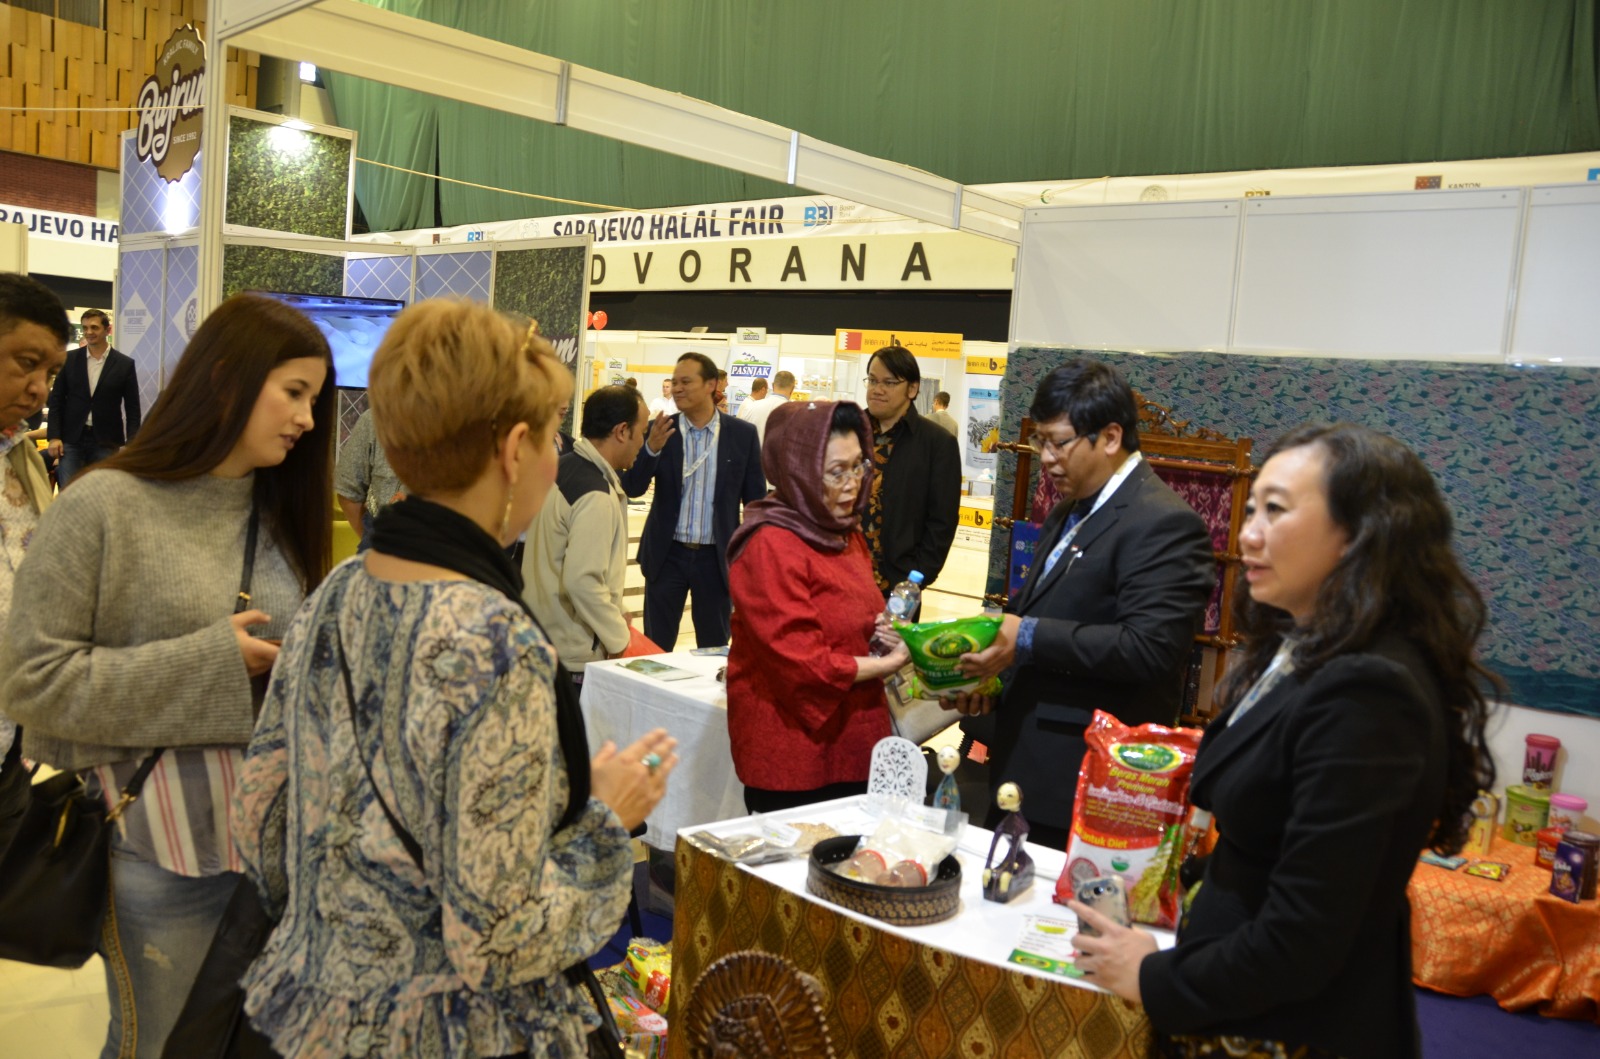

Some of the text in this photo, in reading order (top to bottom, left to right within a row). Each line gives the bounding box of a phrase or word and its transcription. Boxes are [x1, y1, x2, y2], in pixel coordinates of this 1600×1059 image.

[173, 134, 186, 144] SINCE
[553, 204, 784, 242] SARAJEVO HALAL FAIR
[591, 241, 932, 285] DVORANA
[731, 364, 771, 377] PAŠNJAK
